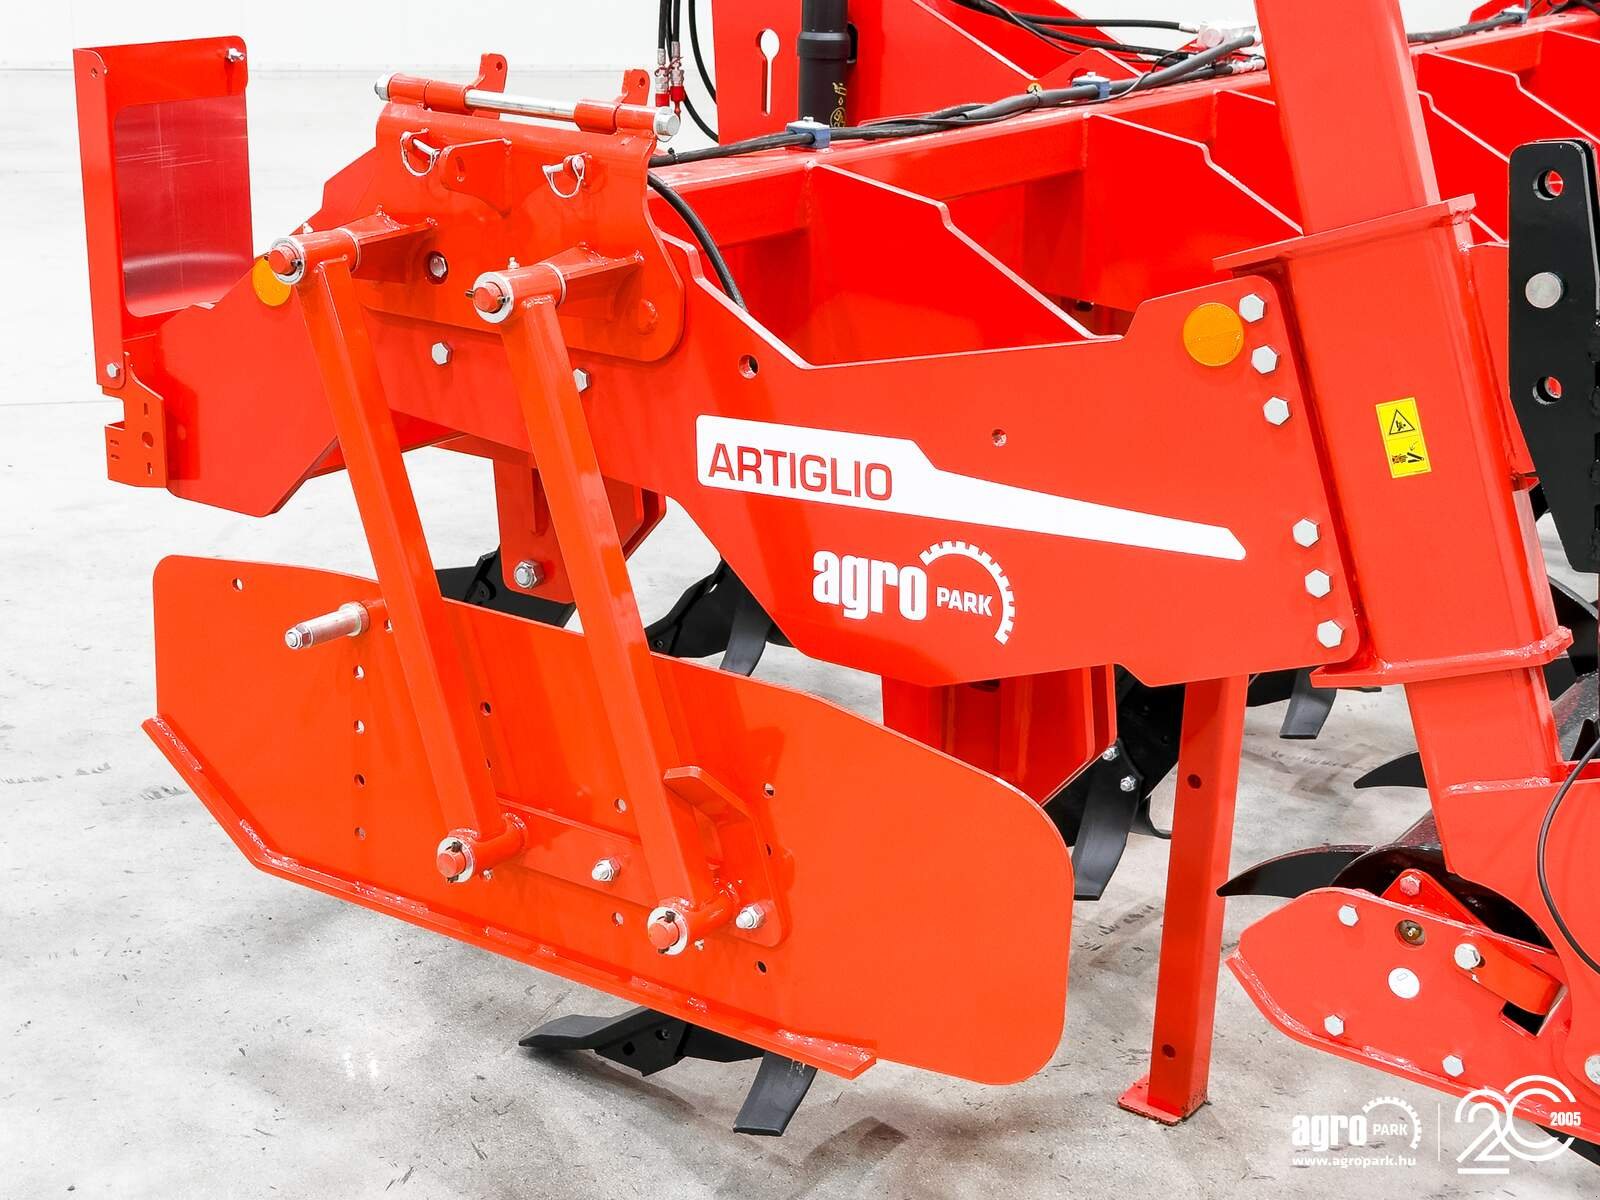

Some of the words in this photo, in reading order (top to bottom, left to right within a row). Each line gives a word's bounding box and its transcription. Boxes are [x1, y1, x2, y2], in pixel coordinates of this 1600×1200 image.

[708, 442, 893, 501] ARTIGLIO
[812, 550, 928, 621] agro
[936, 586, 993, 617] PARK
